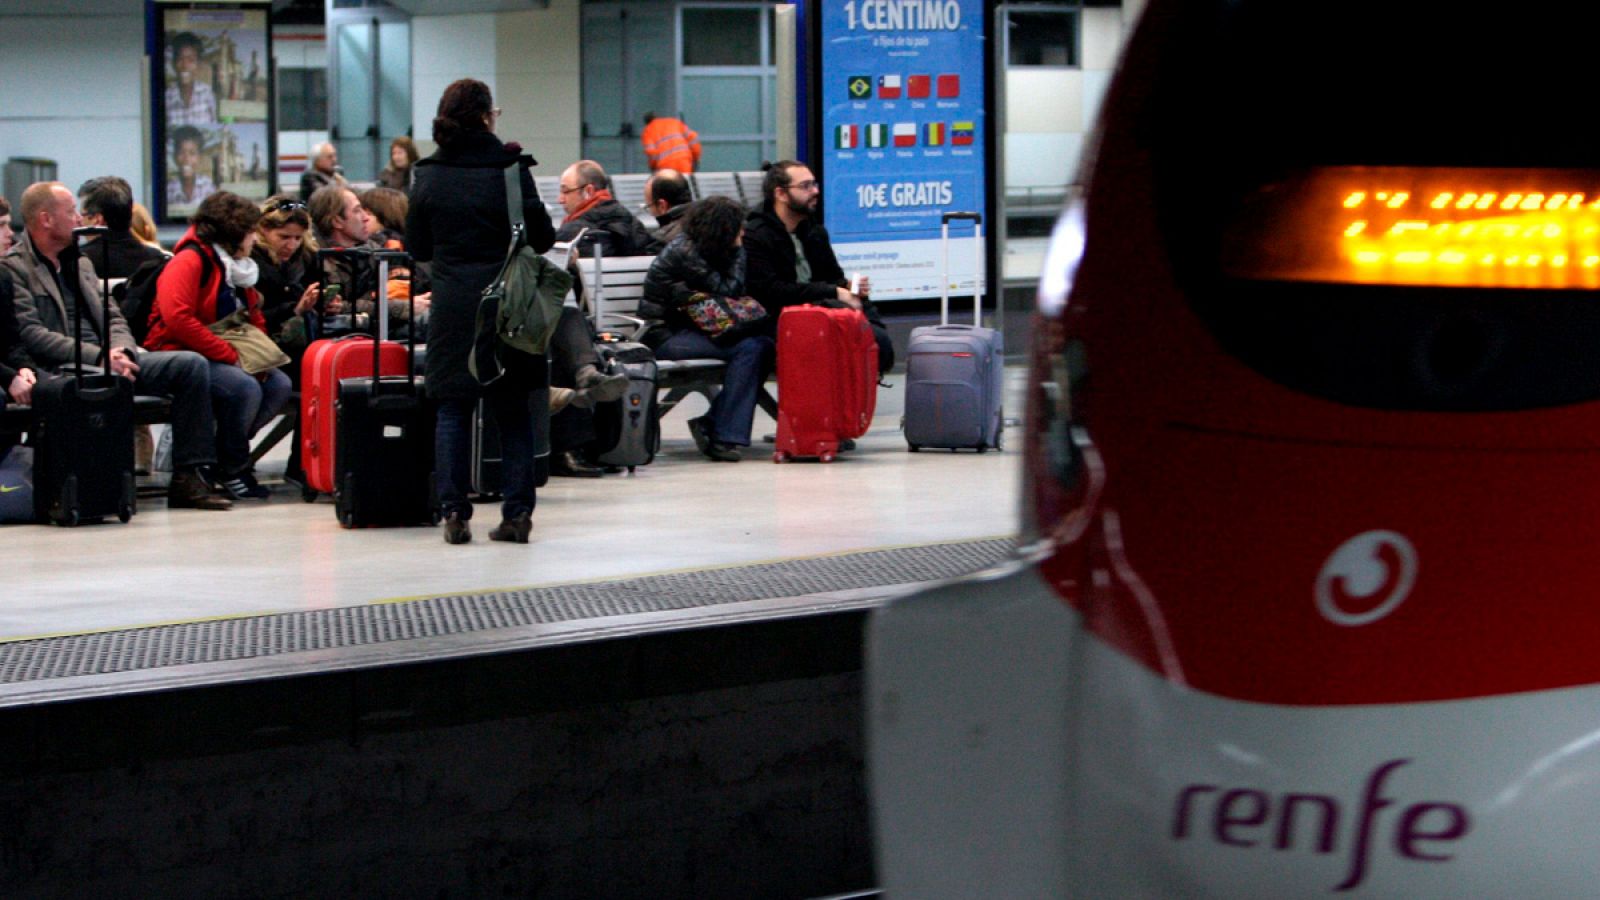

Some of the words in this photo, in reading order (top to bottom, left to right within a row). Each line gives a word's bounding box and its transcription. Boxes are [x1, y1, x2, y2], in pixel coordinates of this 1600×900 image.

[844, 1, 856, 30] 1
[856, 183, 889, 208] 10€
[891, 181, 953, 207] GRATIS
[1171, 758, 1471, 892] renfe
